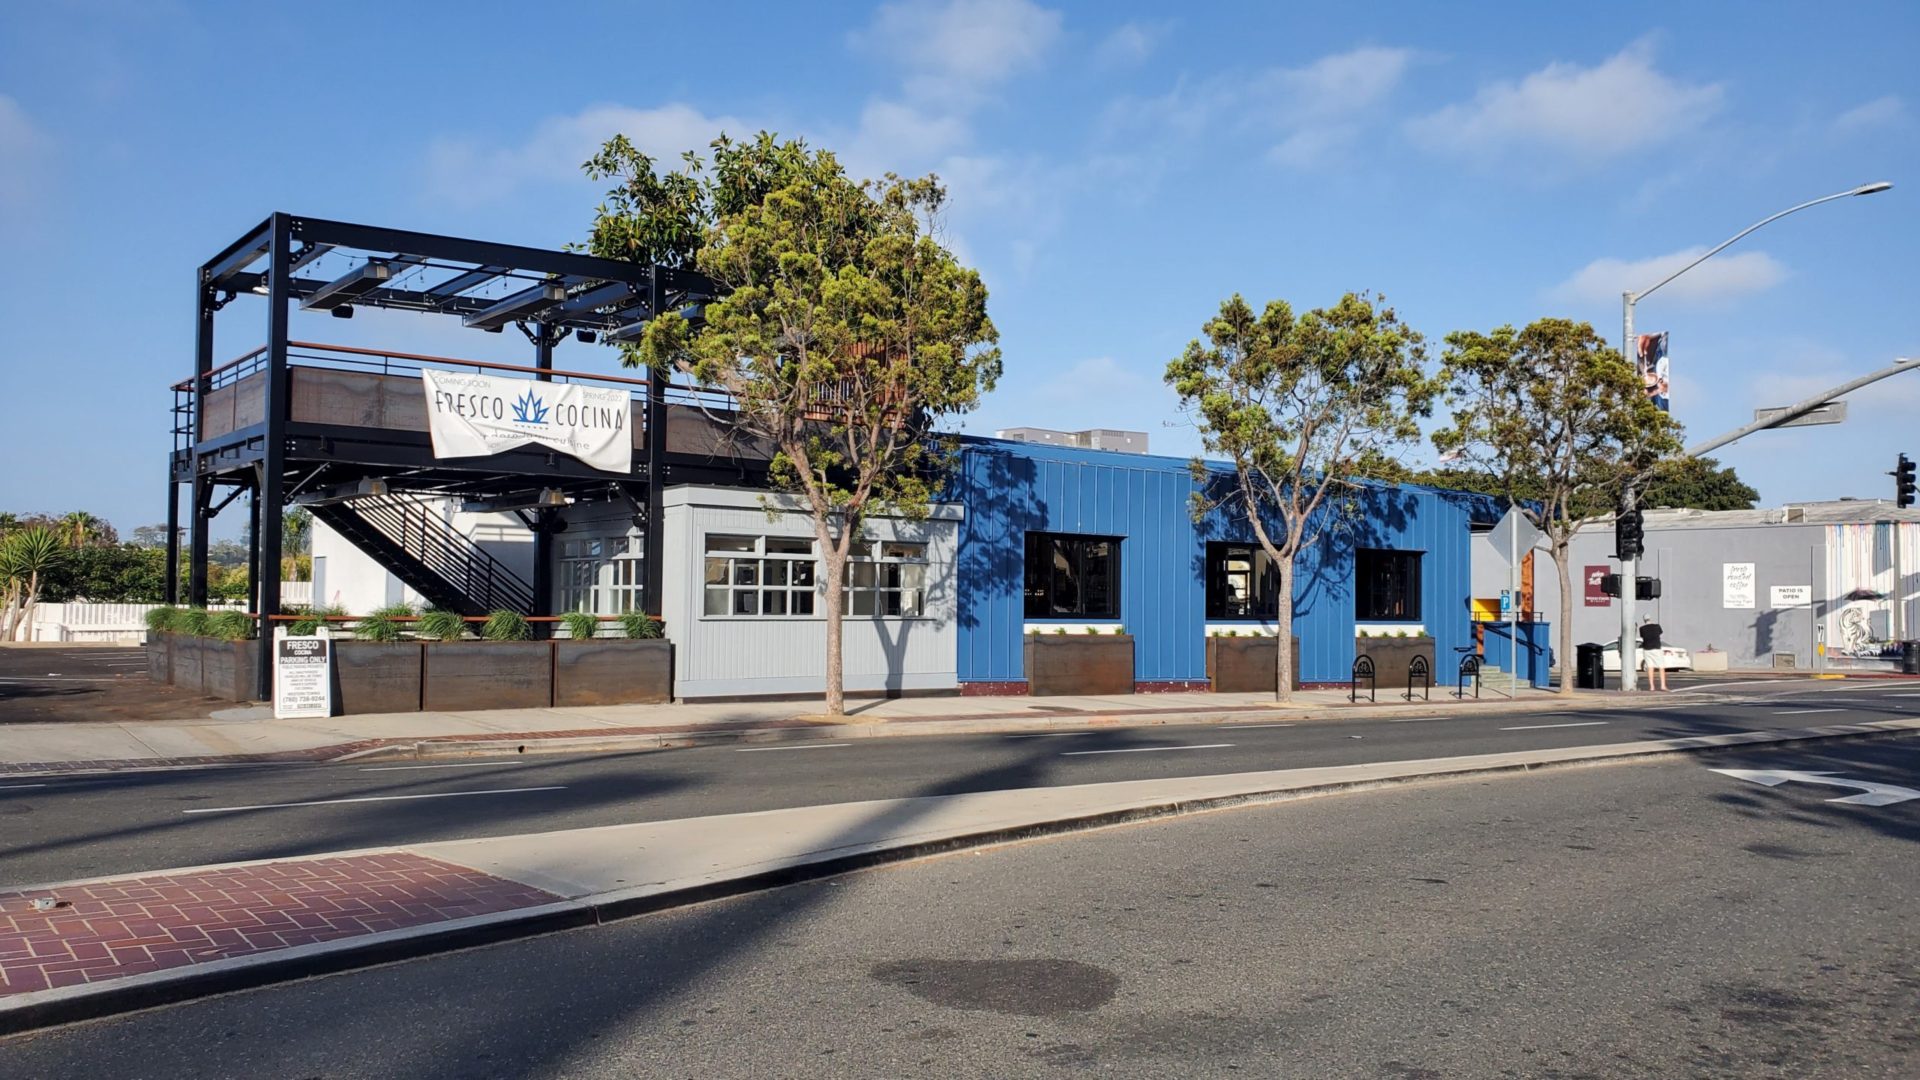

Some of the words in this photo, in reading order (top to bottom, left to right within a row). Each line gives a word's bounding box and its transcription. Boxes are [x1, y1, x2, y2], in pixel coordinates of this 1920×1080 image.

[433, 376, 466, 386] COMING
[467, 379, 491, 388] SOON
[582, 391, 606, 401] SPRING
[435, 390, 504, 420] FRESCO
[555, 403, 623, 431] COCINA
[287, 641, 318, 650] FRESCO
[280, 656, 309, 664] PARKING
